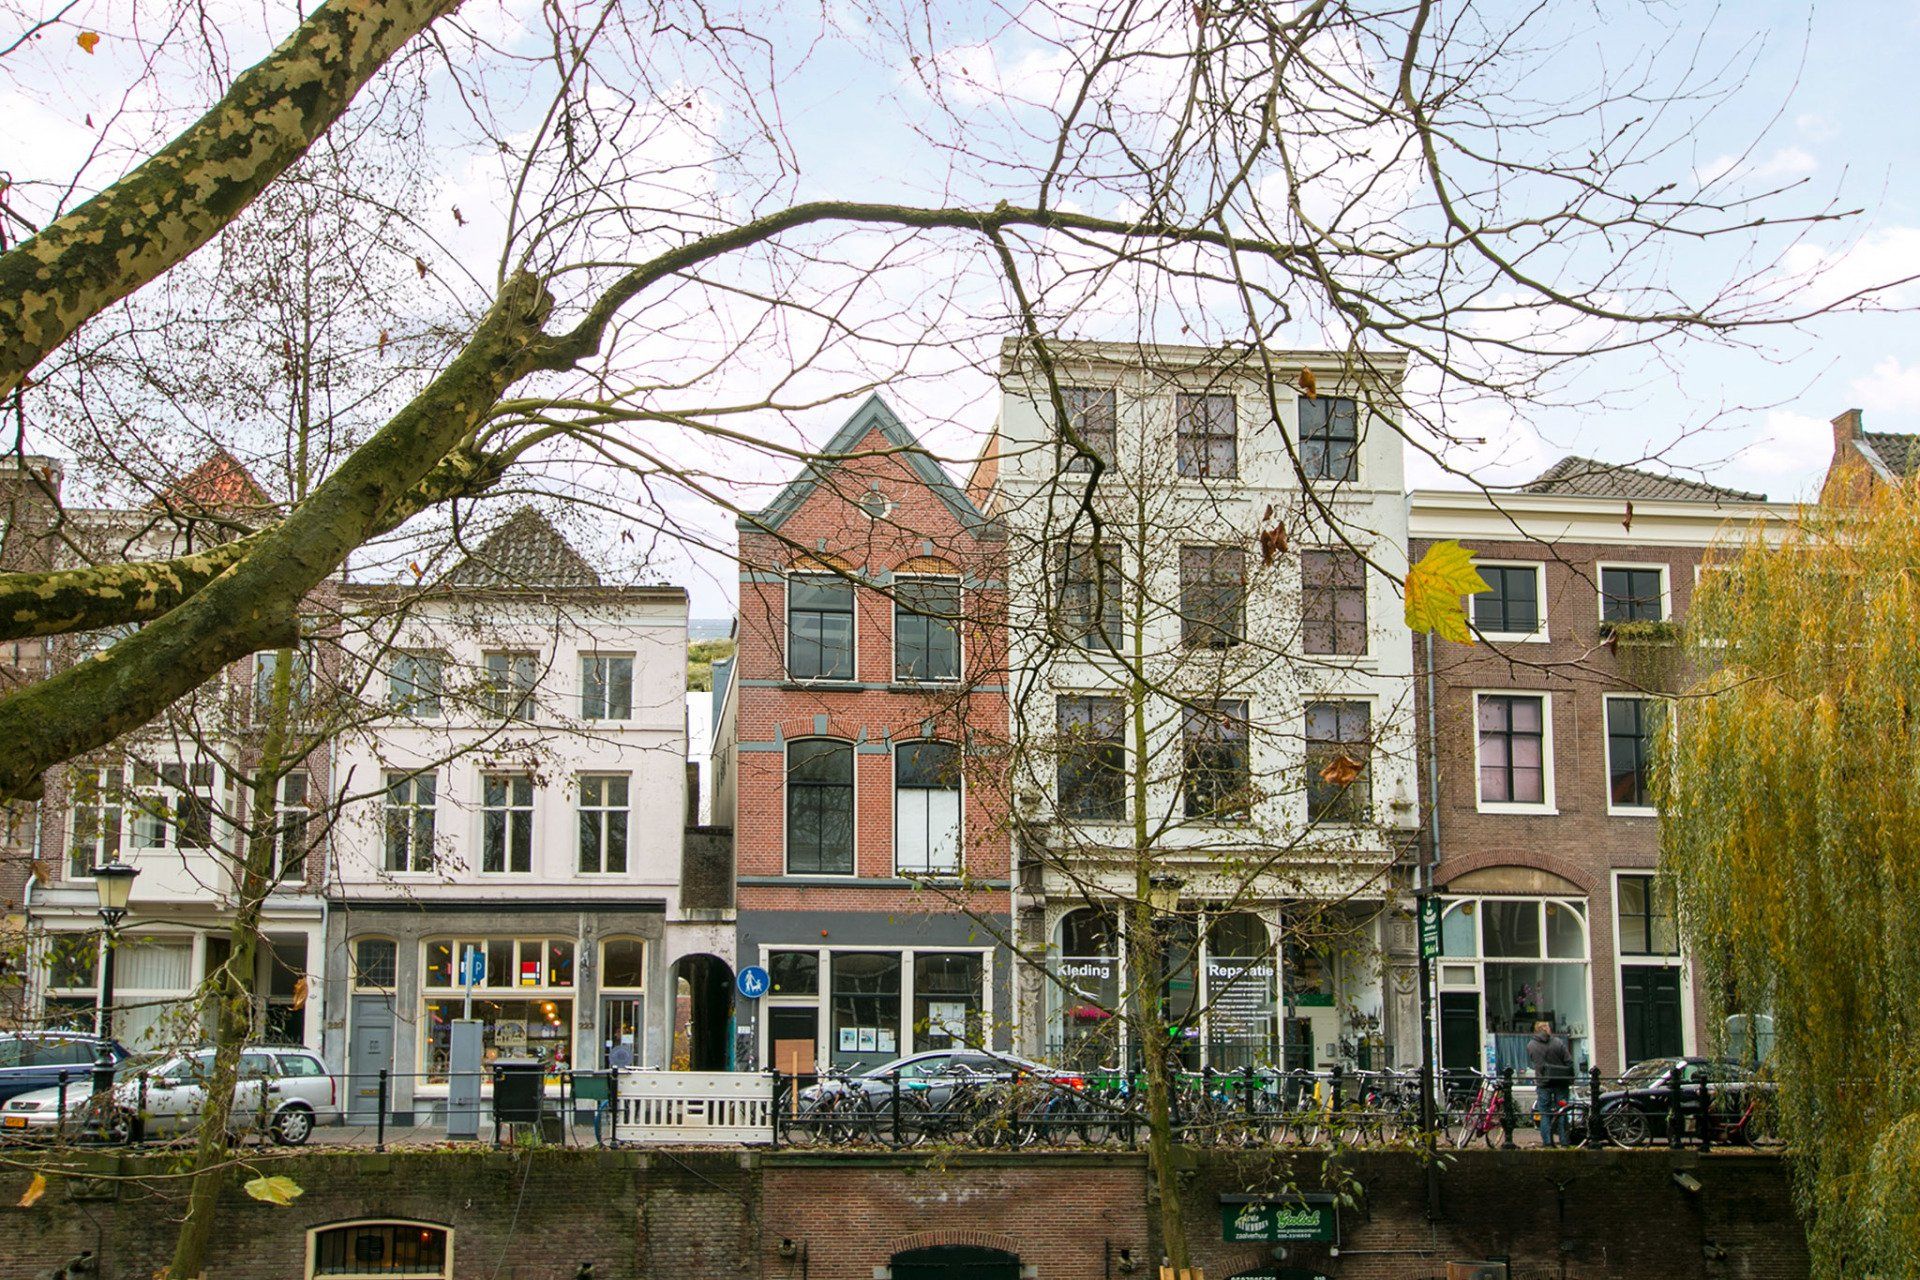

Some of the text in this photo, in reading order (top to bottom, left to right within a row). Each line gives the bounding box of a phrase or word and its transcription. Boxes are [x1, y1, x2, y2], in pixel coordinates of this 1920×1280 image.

[1057, 964, 1110, 979] Kleding
[1209, 964, 1274, 978] Repaatie
[1277, 1209, 1321, 1229] Grolsch
